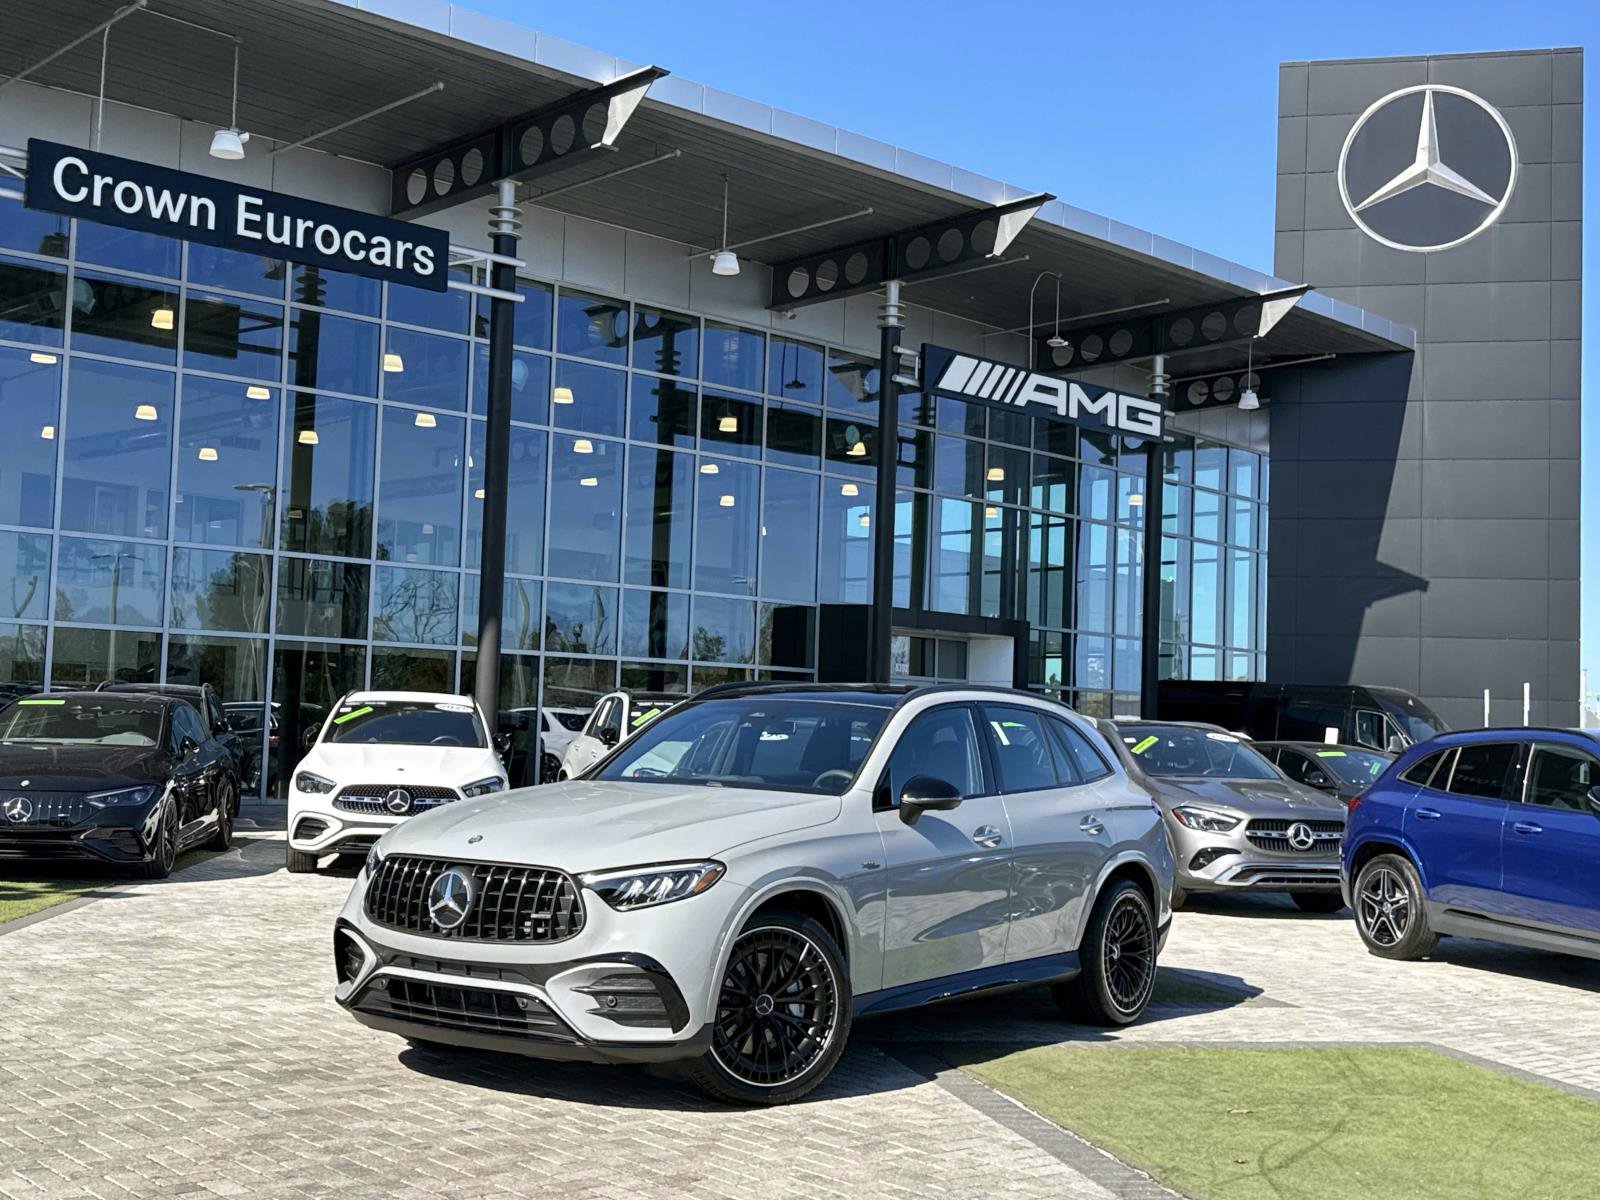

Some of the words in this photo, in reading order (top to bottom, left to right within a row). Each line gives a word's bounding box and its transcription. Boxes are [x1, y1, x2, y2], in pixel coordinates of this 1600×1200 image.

[53, 156, 216, 230] Crown
[236, 193, 435, 275] Eurocars
[1014, 373, 1161, 437] AMG
